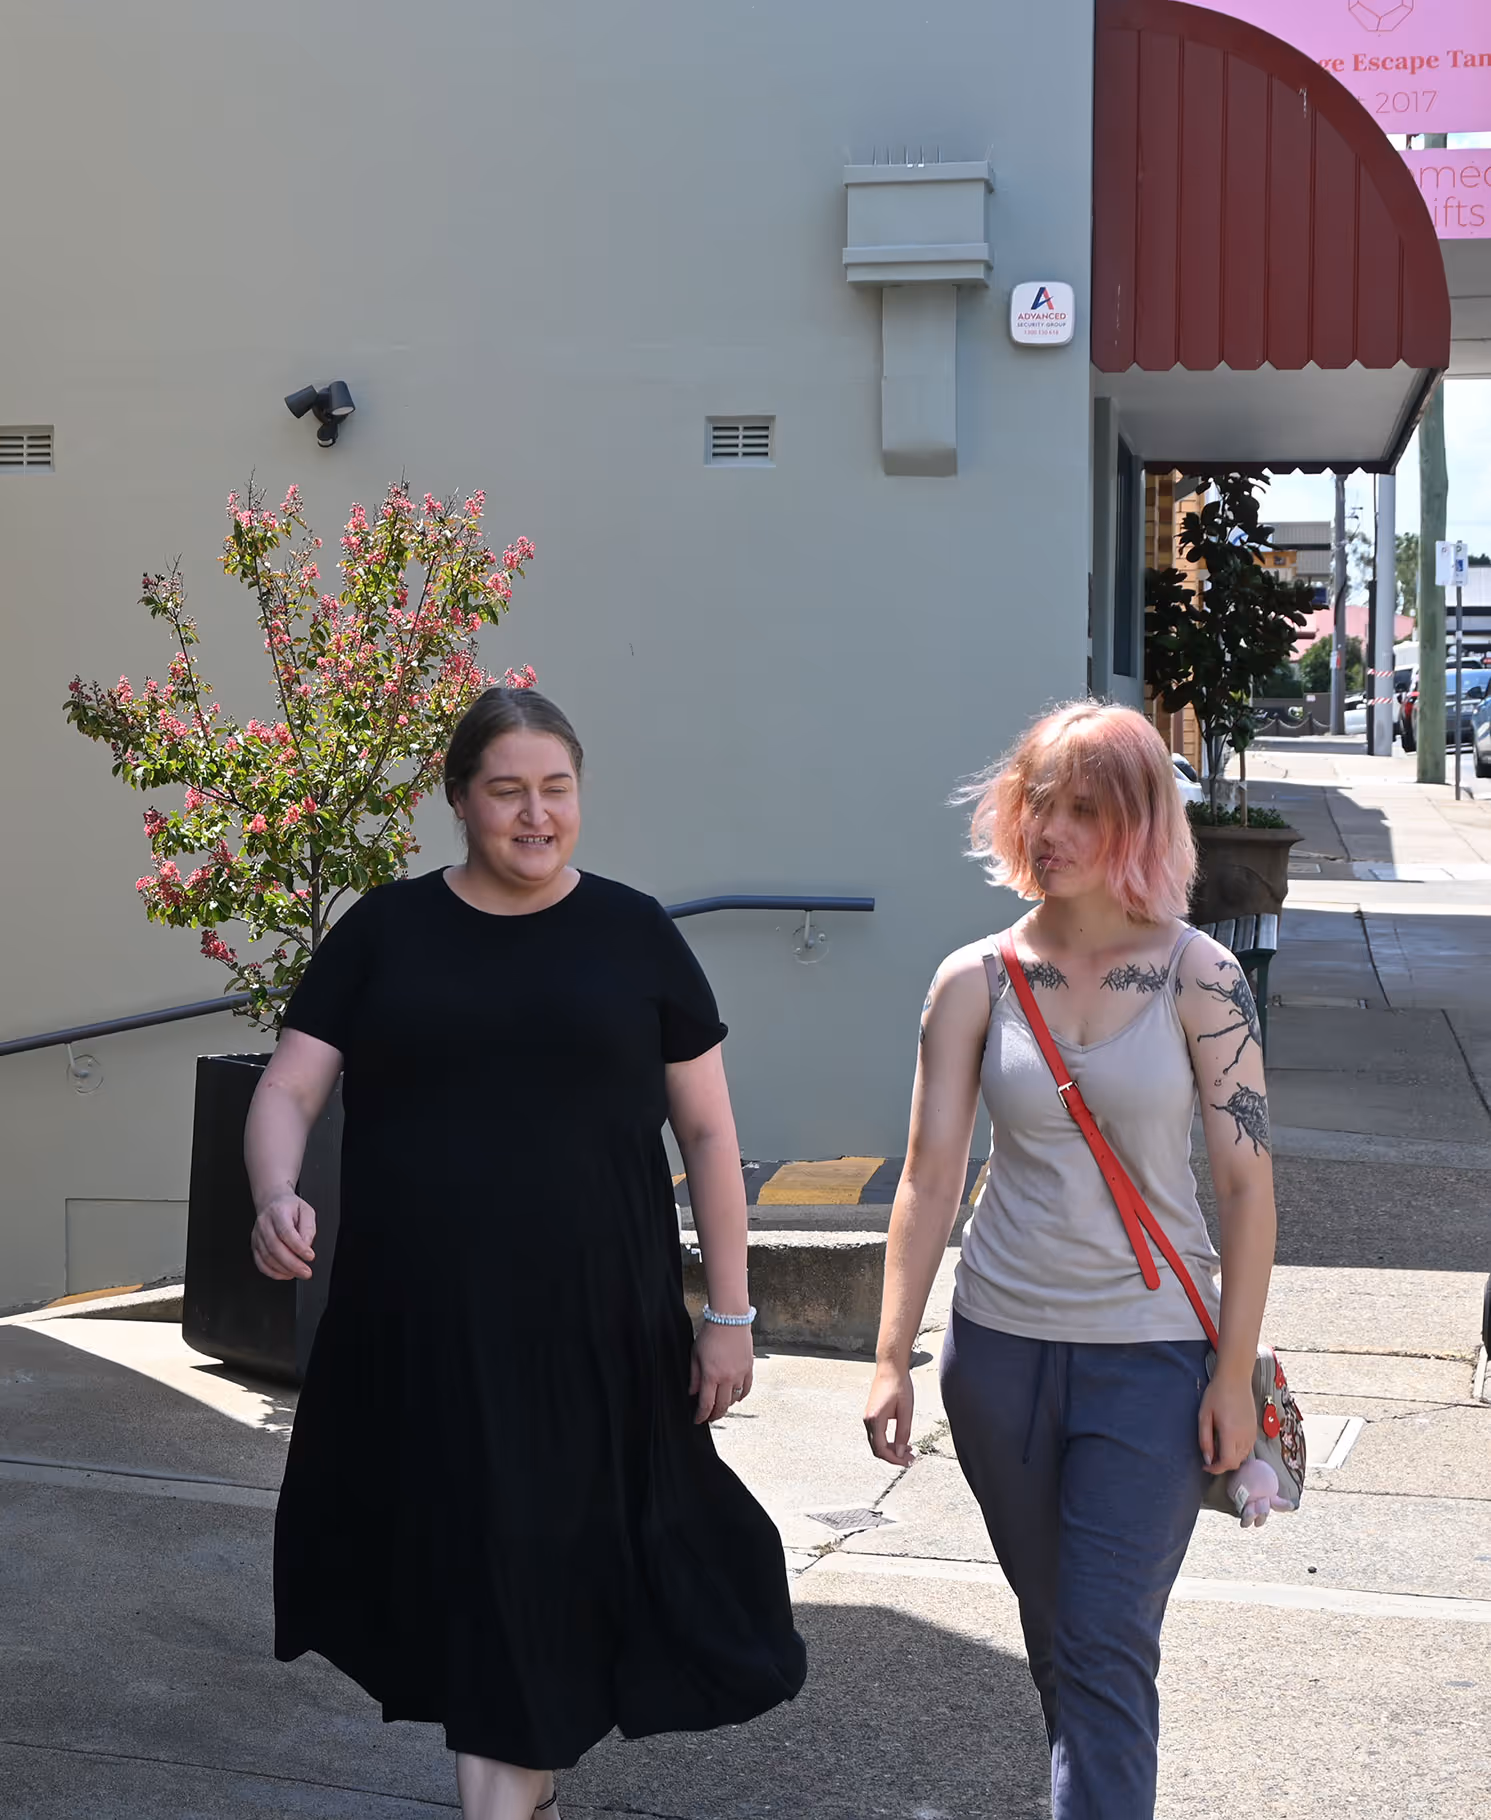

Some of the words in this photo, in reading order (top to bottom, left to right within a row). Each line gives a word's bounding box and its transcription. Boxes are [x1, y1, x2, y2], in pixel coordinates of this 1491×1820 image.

[1352, 53, 1440, 75] Escape
[1446, 50, 1491, 68] Tan
[1375, 90, 1438, 114] 2017
[1017, 312, 1067, 320] ADVANCED
